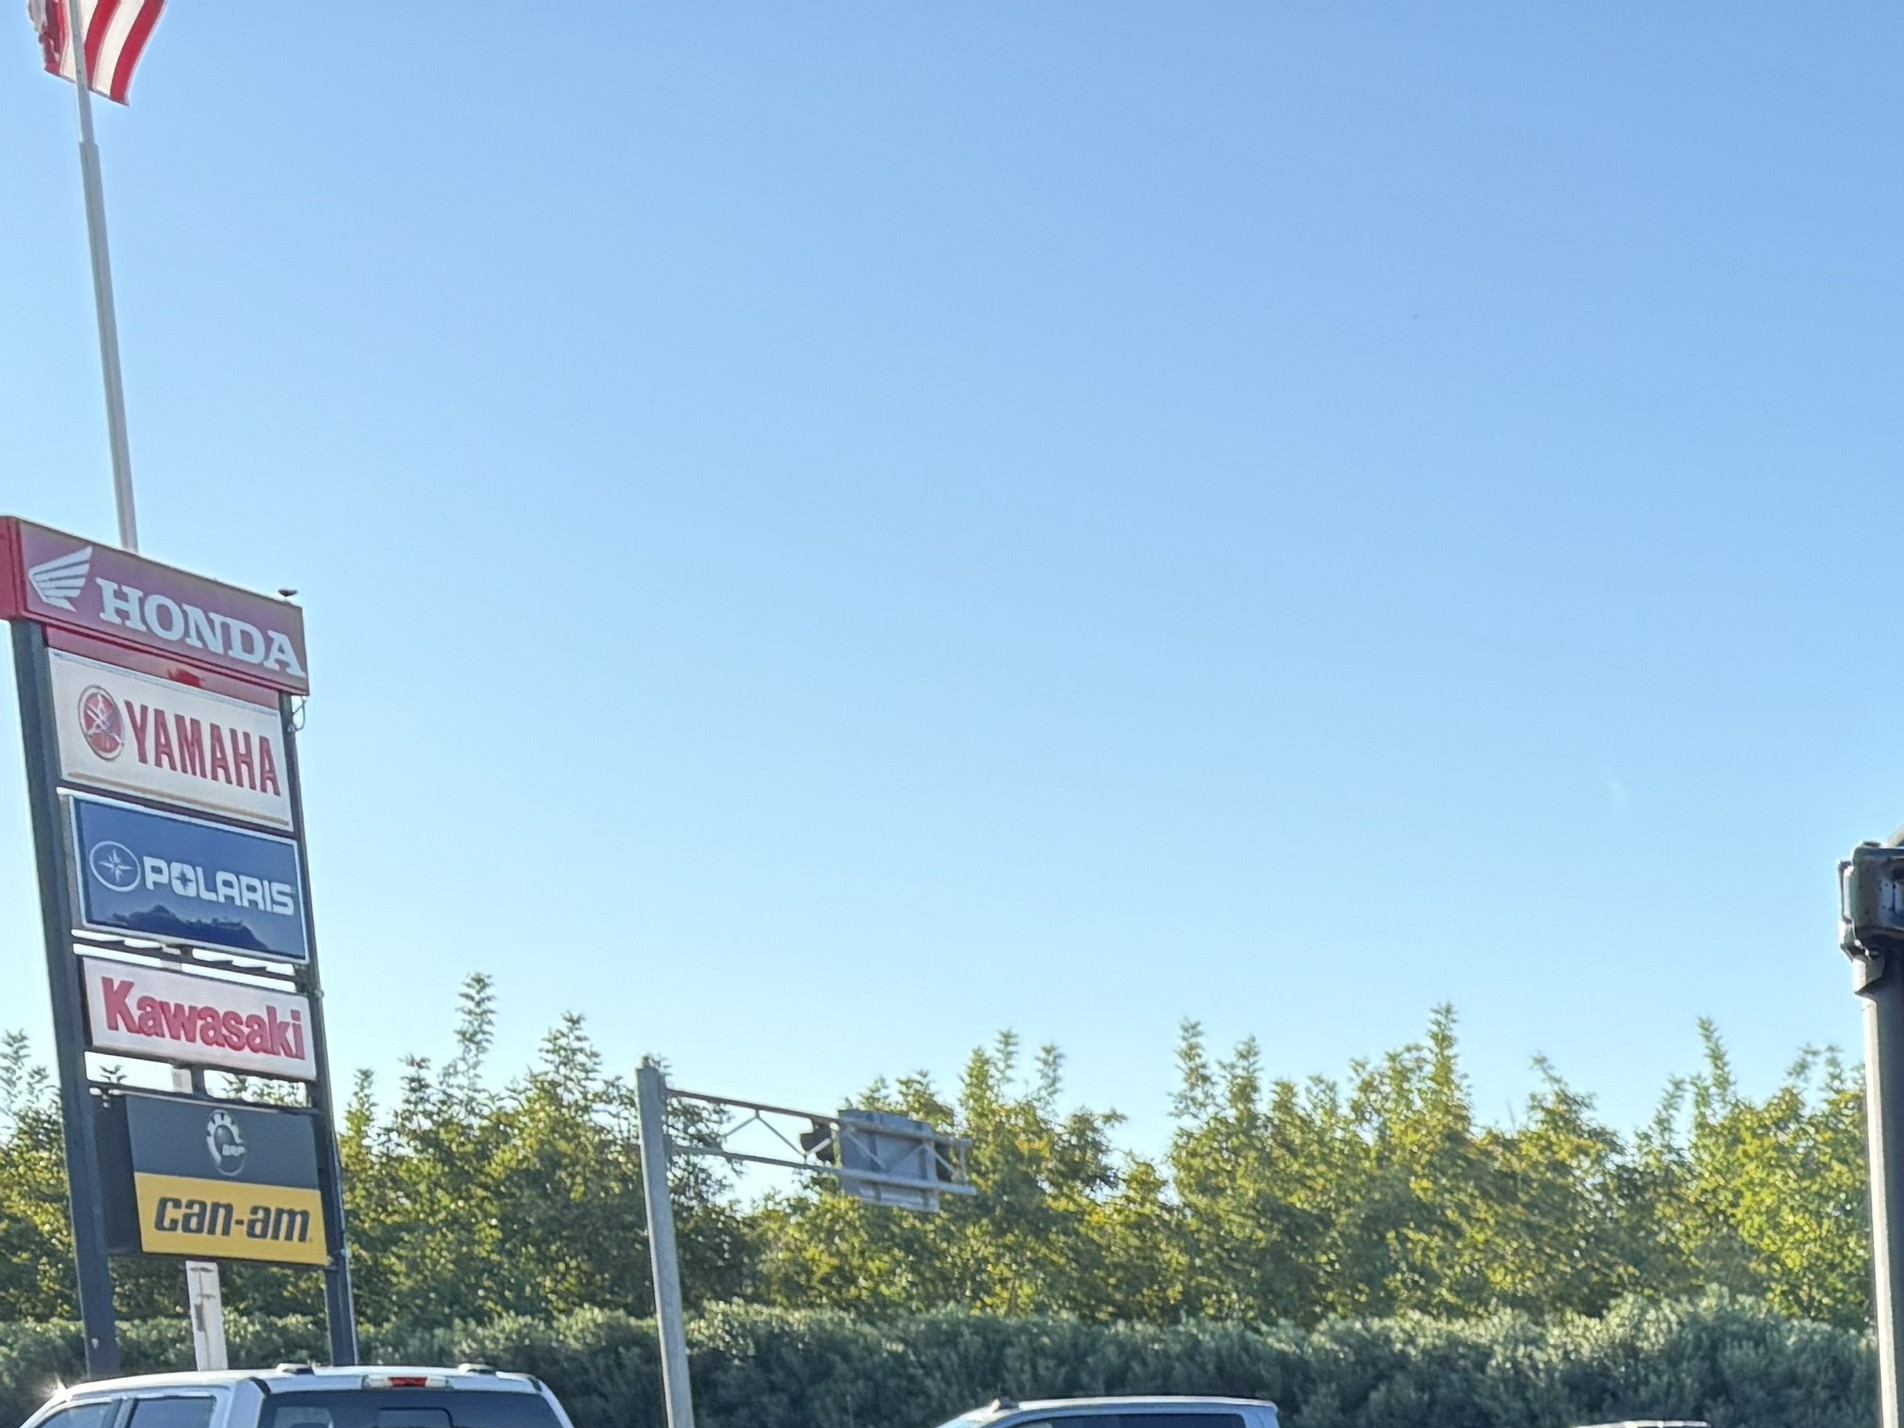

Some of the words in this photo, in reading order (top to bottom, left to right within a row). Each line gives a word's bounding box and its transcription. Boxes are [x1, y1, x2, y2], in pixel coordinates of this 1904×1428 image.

[96, 577, 306, 678] HONDA
[123, 699, 281, 797] YAMAHA
[143, 856, 295, 916] POLARIS
[101, 976, 306, 1061] Kawasaki
[154, 1196, 311, 1243] can-am
